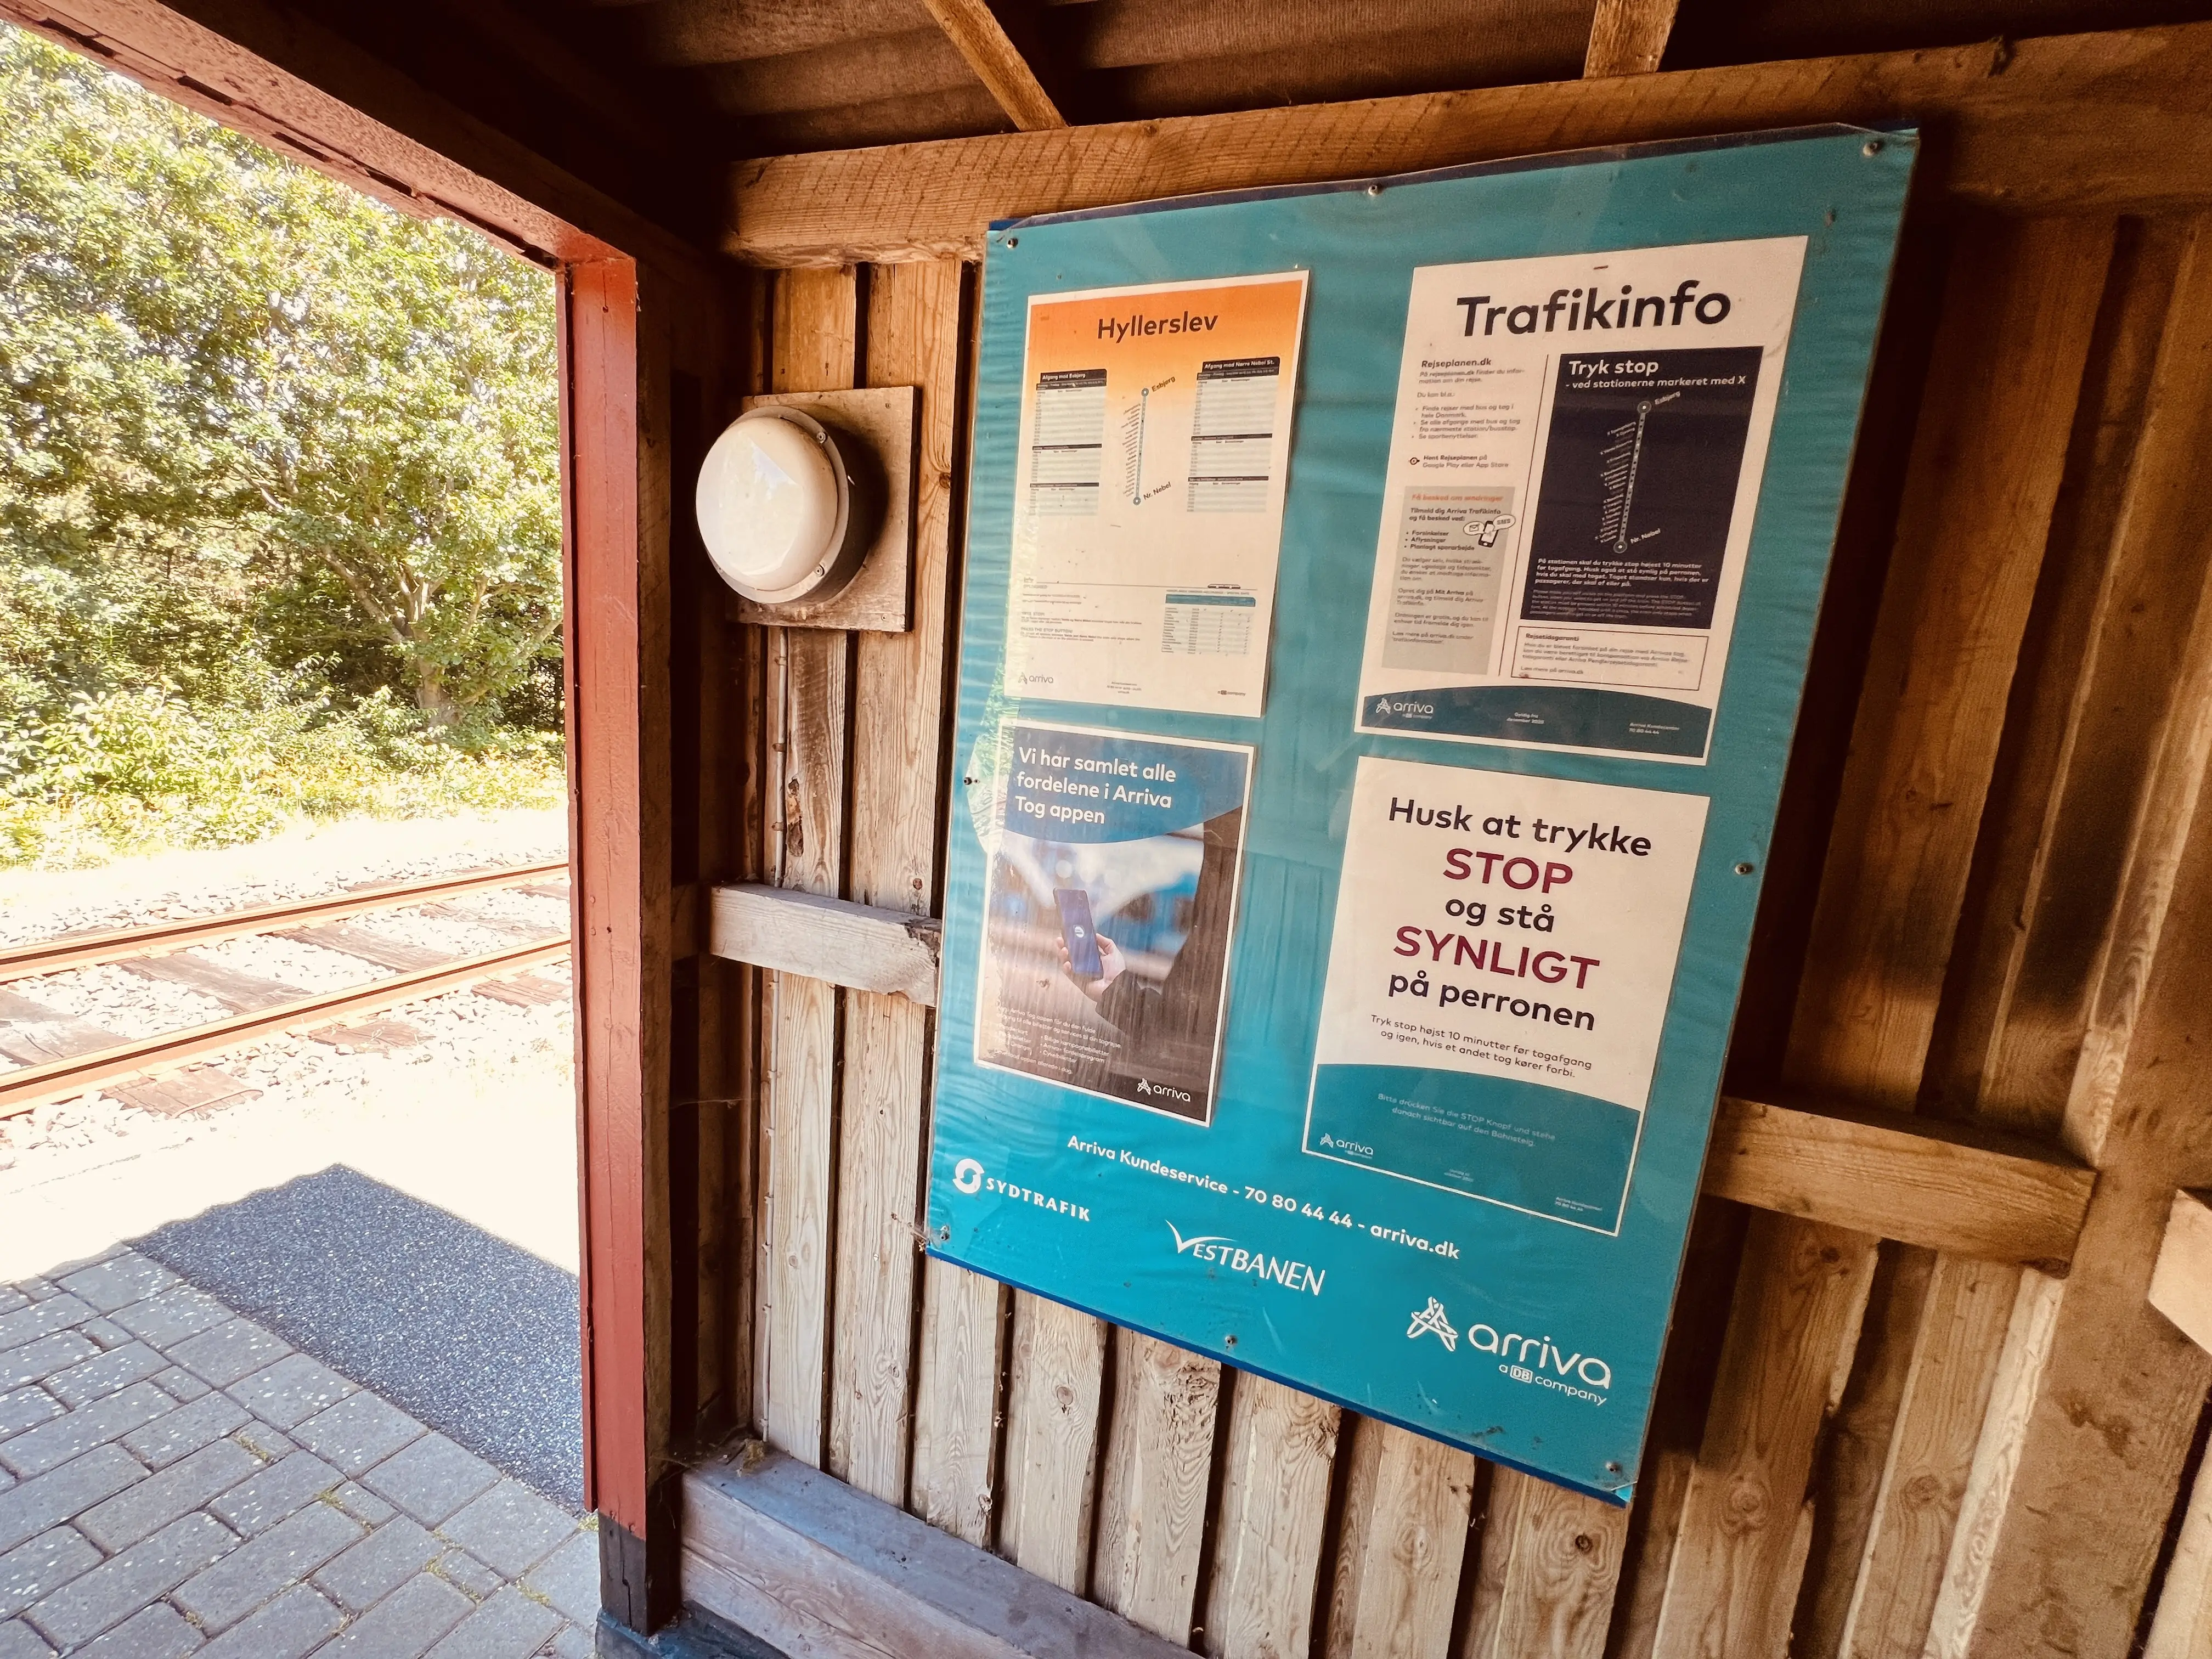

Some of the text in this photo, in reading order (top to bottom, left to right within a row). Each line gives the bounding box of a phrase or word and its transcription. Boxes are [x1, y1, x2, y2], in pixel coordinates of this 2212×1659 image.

[1457, 280, 1731, 337] Trafikinfo
[1098, 311, 1218, 343] Hyllerslev
[1421, 358, 1491, 369] Rejseplanen.dk
[1569, 359, 1658, 378] Tryk stop
[1572, 380, 1590, 388] ved
[1593, 379, 1655, 388] stationerne
[1657, 377, 1708, 386] markeret
[1711, 376, 1734, 385] med
[1737, 375, 1746, 383] X
[1152, 376, 1176, 392] Esbjerg
[1153, 481, 1171, 495] Nebel
[1029, 674, 1053, 684] arriva
[1393, 701, 1434, 713] arriva
[1019, 747, 1176, 782] Vi har samlet alle
[1017, 771, 1172, 809] fordelene i Arriva
[1015, 795, 1105, 823] Tog appen
[1389, 797, 1651, 856] Husk at trykke
[1443, 848, 1573, 894] STOP
[1445, 899, 1554, 933] og stå
[1393, 926, 1600, 989] SYNLIGT
[1388, 970, 1595, 1031] på perronen
[1371, 1015, 1592, 1070] Tryk stop højst 10 minutter før togafgang
[1381, 1031, 1575, 1078] og igen, hvis et andet tog kører forbi.
[1153, 1085, 1190, 1102] arriva
[1378, 1093, 1397, 1104] Bitte
[1399, 1096, 1430, 1112] drücken
[1432, 1105, 1444, 1114] Sie
[1447, 1109, 1459, 1118] die
[1460, 1112, 1485, 1123] STOP
[1487, 1119, 1511, 1132] Knopf
[1514, 1124, 1530, 1134] und
[1392, 1107, 1421, 1120] danach
[1423, 1114, 1455, 1127] sichtbar
[1458, 1122, 1472, 1132] auf
[1336, 1139, 1373, 1155] arriva
[987, 1178, 1090, 1222] SYDTRAFIK
[1068, 1135, 1116, 1160] Arriva
[1120, 1150, 1228, 1194] Kundeservice
[1245, 1186, 1267, 1204] 70
[1272, 1194, 1296, 1212] 80
[1301, 1203, 1324, 1222] 44
[1329, 1211, 1352, 1229] 44
[1370, 1223, 1461, 1260] arriva.dk
[1165, 1220, 1325, 1296] VESTBANEN
[1468, 1324, 1611, 1389] arriva
[1499, 1364, 1607, 1406] a DB company
